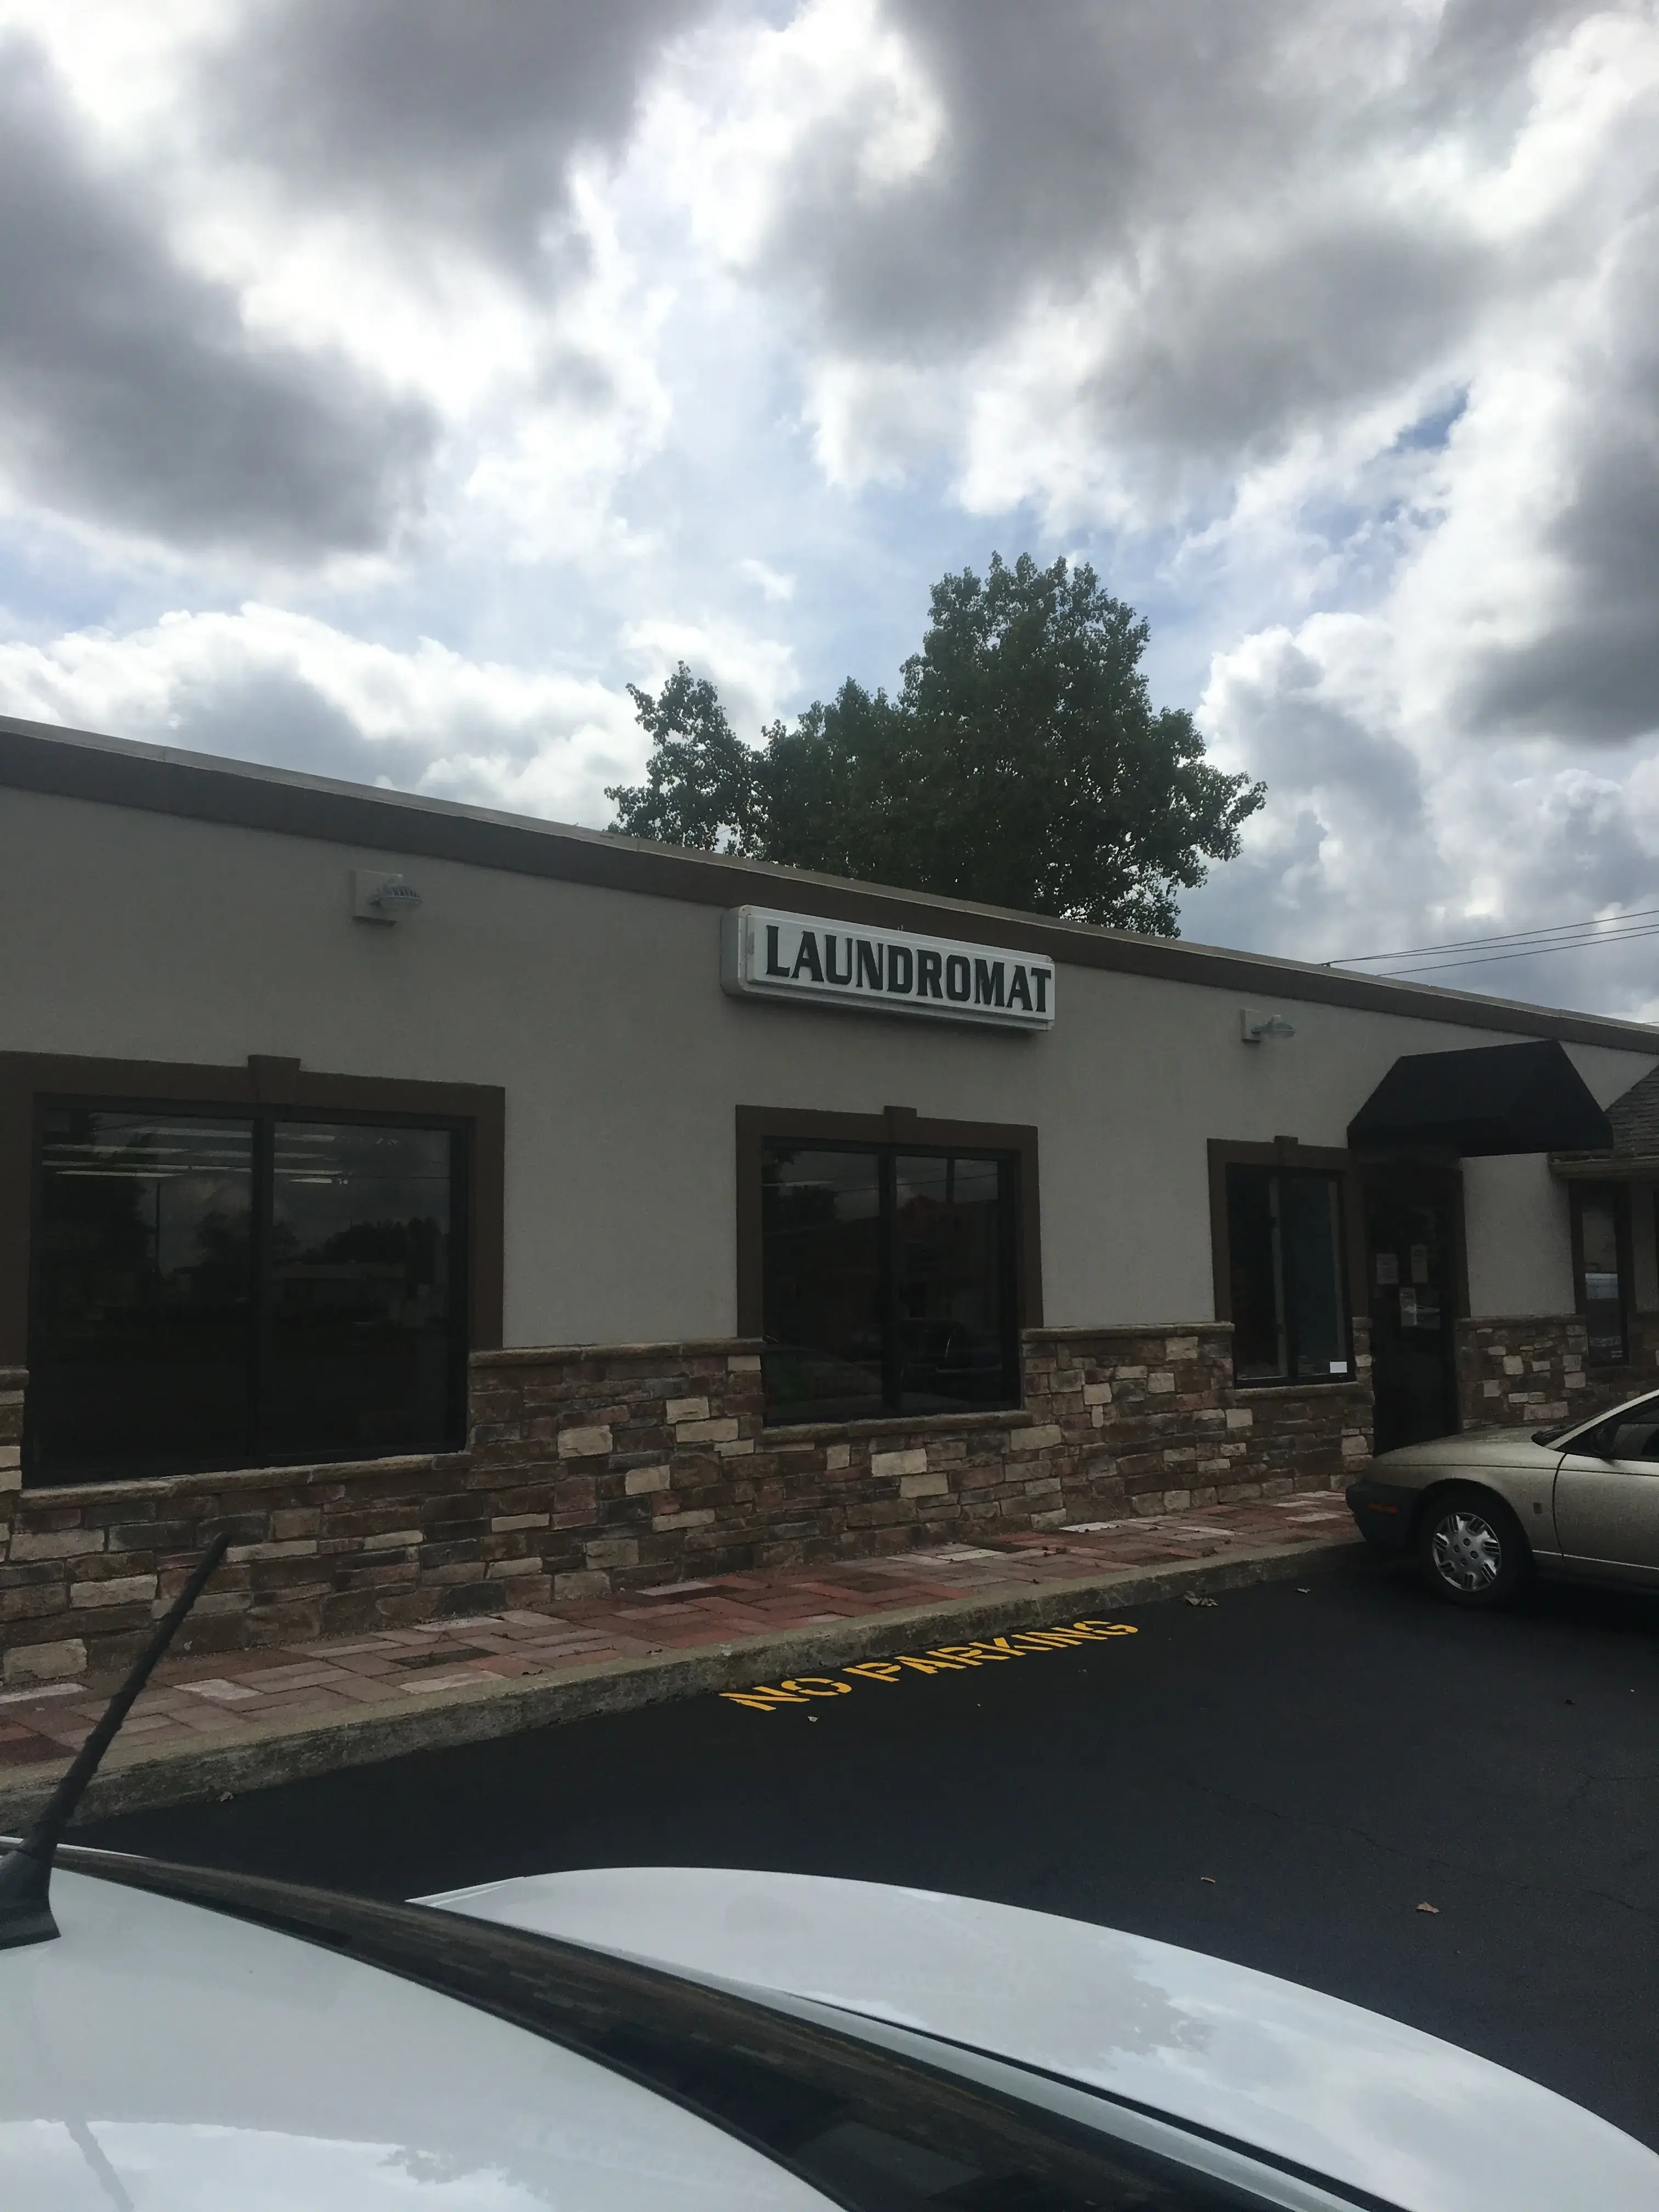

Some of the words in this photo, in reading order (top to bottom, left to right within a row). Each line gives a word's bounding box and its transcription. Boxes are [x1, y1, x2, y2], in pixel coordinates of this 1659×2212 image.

[765, 924, 1052, 1013] LAUNDROMAT
[719, 1677, 852, 1711] NO
[842, 1620, 1138, 1682] PARKING
